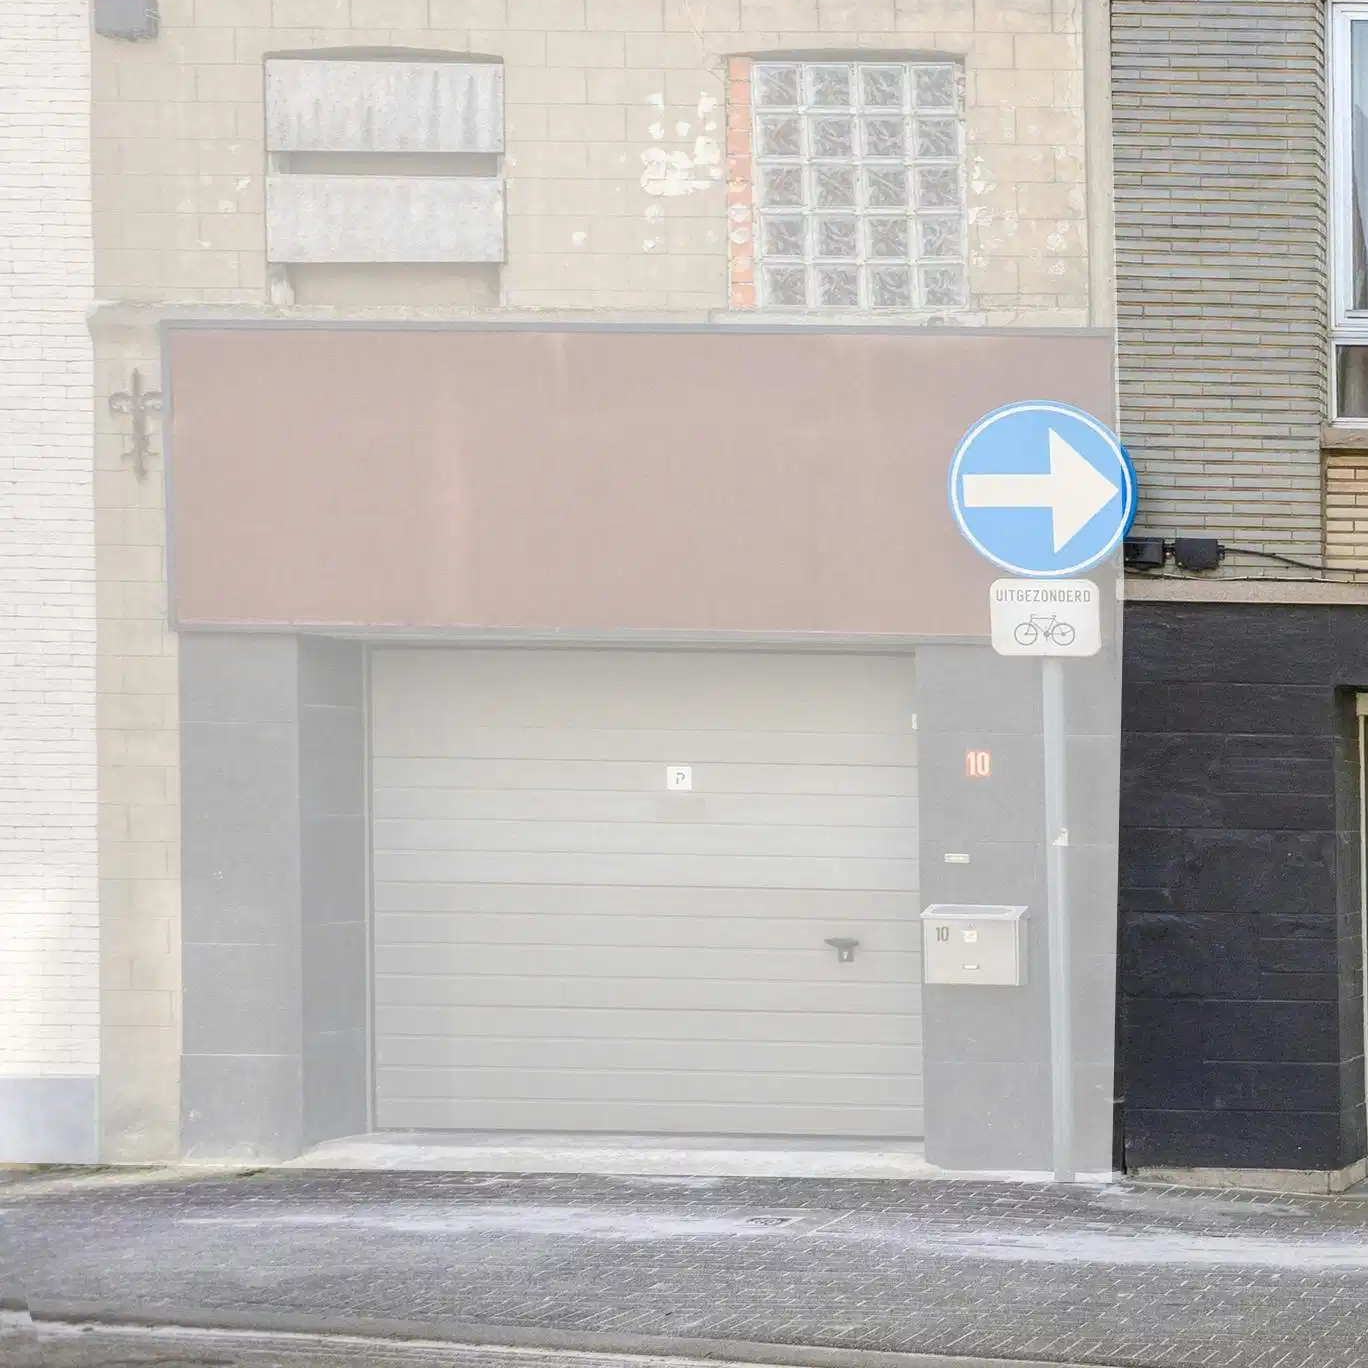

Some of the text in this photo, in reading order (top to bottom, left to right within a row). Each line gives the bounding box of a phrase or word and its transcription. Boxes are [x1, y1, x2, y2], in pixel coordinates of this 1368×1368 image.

[995, 589, 1091, 602] UITGEZONDERD
[967, 751, 989, 775] 10
[935, 926, 949, 942] 10
